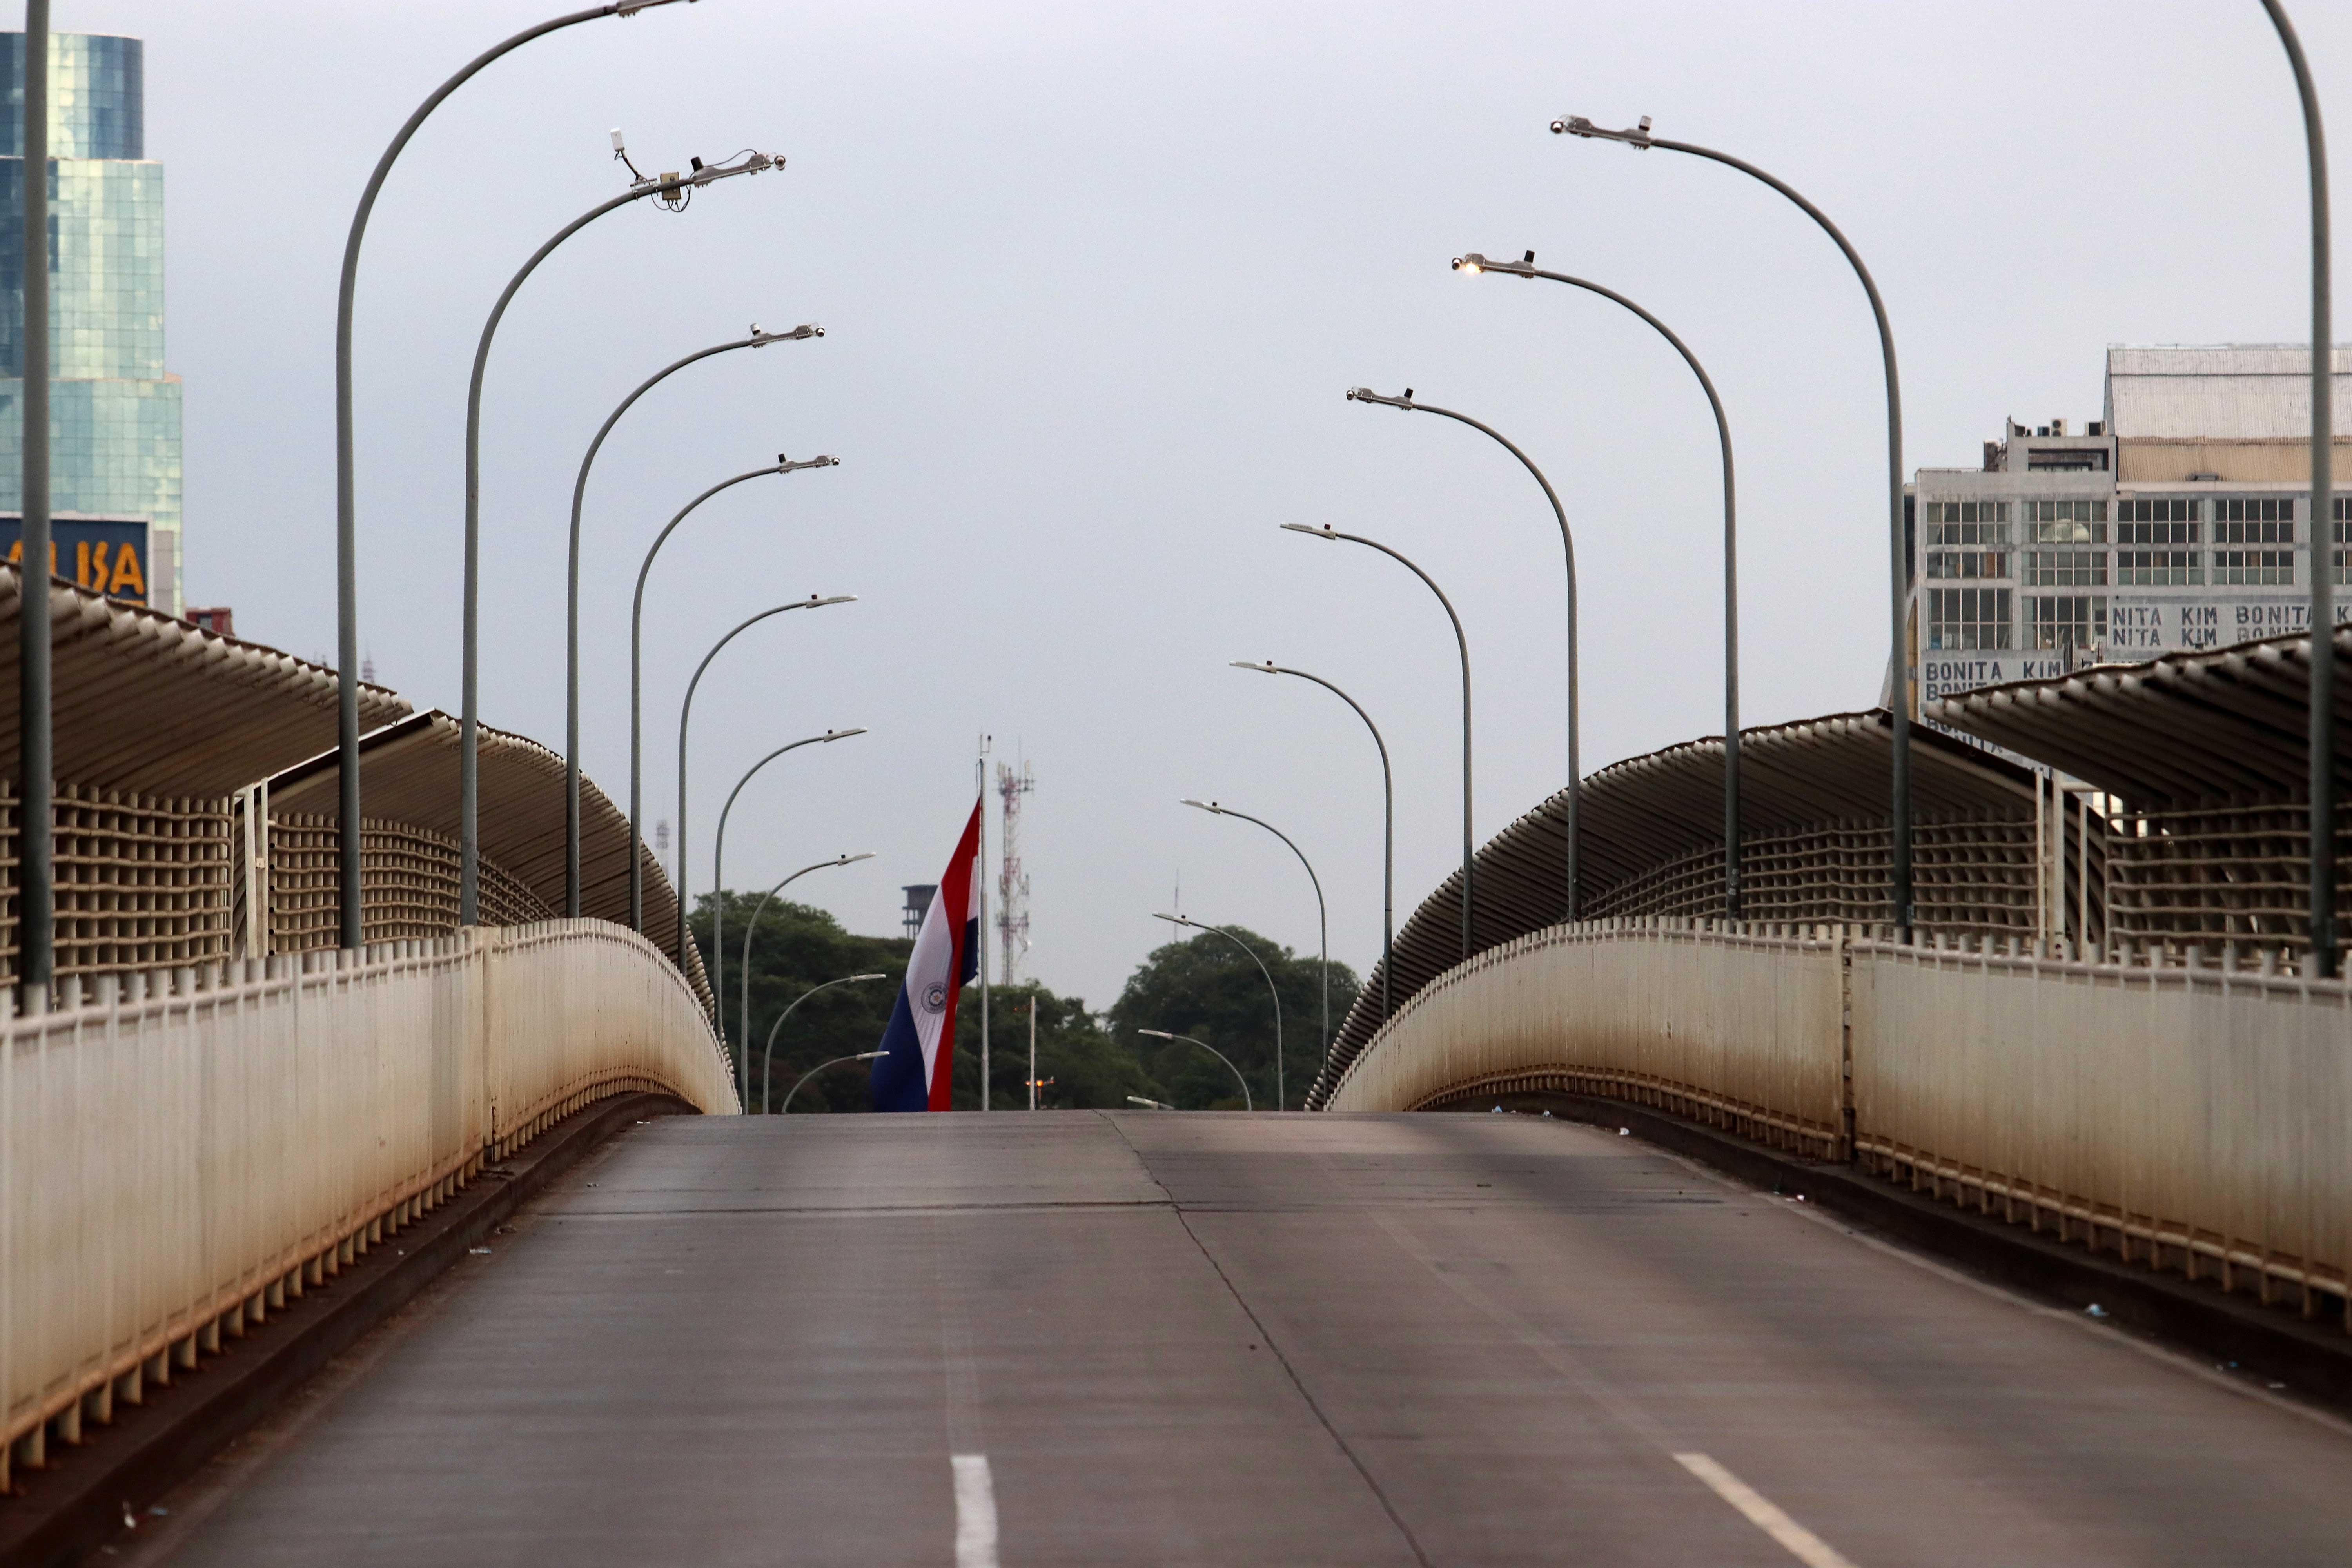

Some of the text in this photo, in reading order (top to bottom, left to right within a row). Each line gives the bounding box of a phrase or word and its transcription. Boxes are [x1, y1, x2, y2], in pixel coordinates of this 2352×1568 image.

[2113, 608, 2161, 626] NITA
[2182, 607, 2218, 626] KIM
[2113, 628, 2161, 646] NITA
[2182, 628, 2217, 646] KIM
[1926, 662, 2002, 681] BONITA
[2023, 661, 2061, 679] KIM
